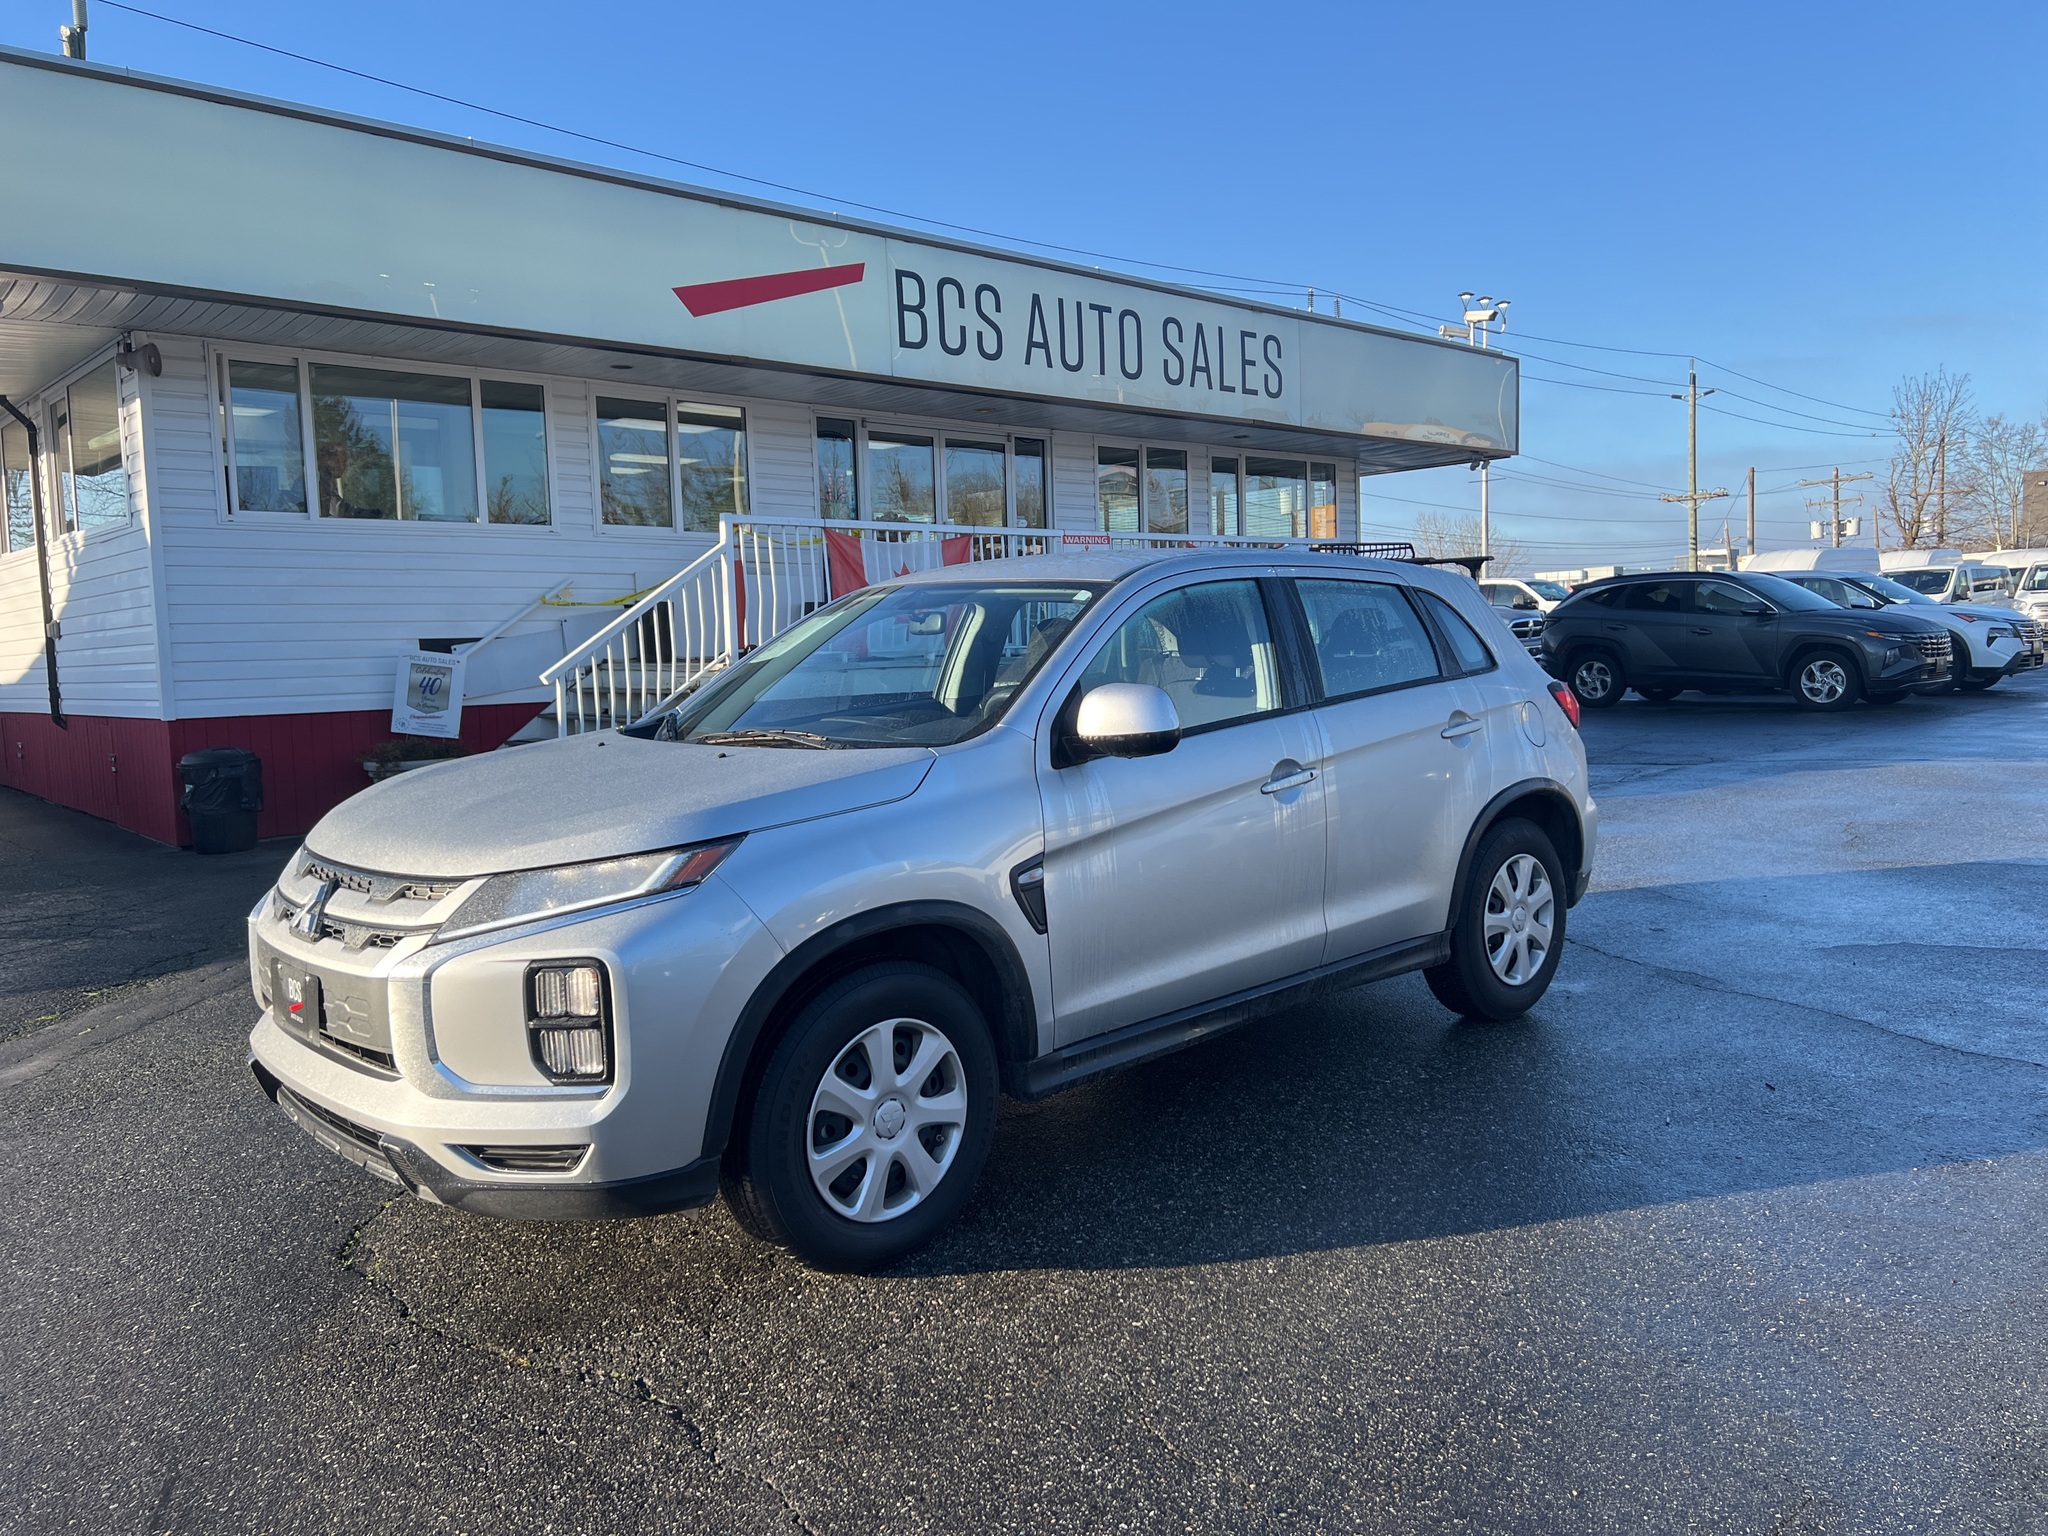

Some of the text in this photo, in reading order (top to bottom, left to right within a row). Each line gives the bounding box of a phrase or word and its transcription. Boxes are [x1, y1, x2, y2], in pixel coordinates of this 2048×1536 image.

[894, 268, 1282, 399] BCS AUTO SALES
[1064, 536, 1108, 544] WARNING
[419, 676, 442, 695] 40
[288, 977, 302, 1003] BCS
